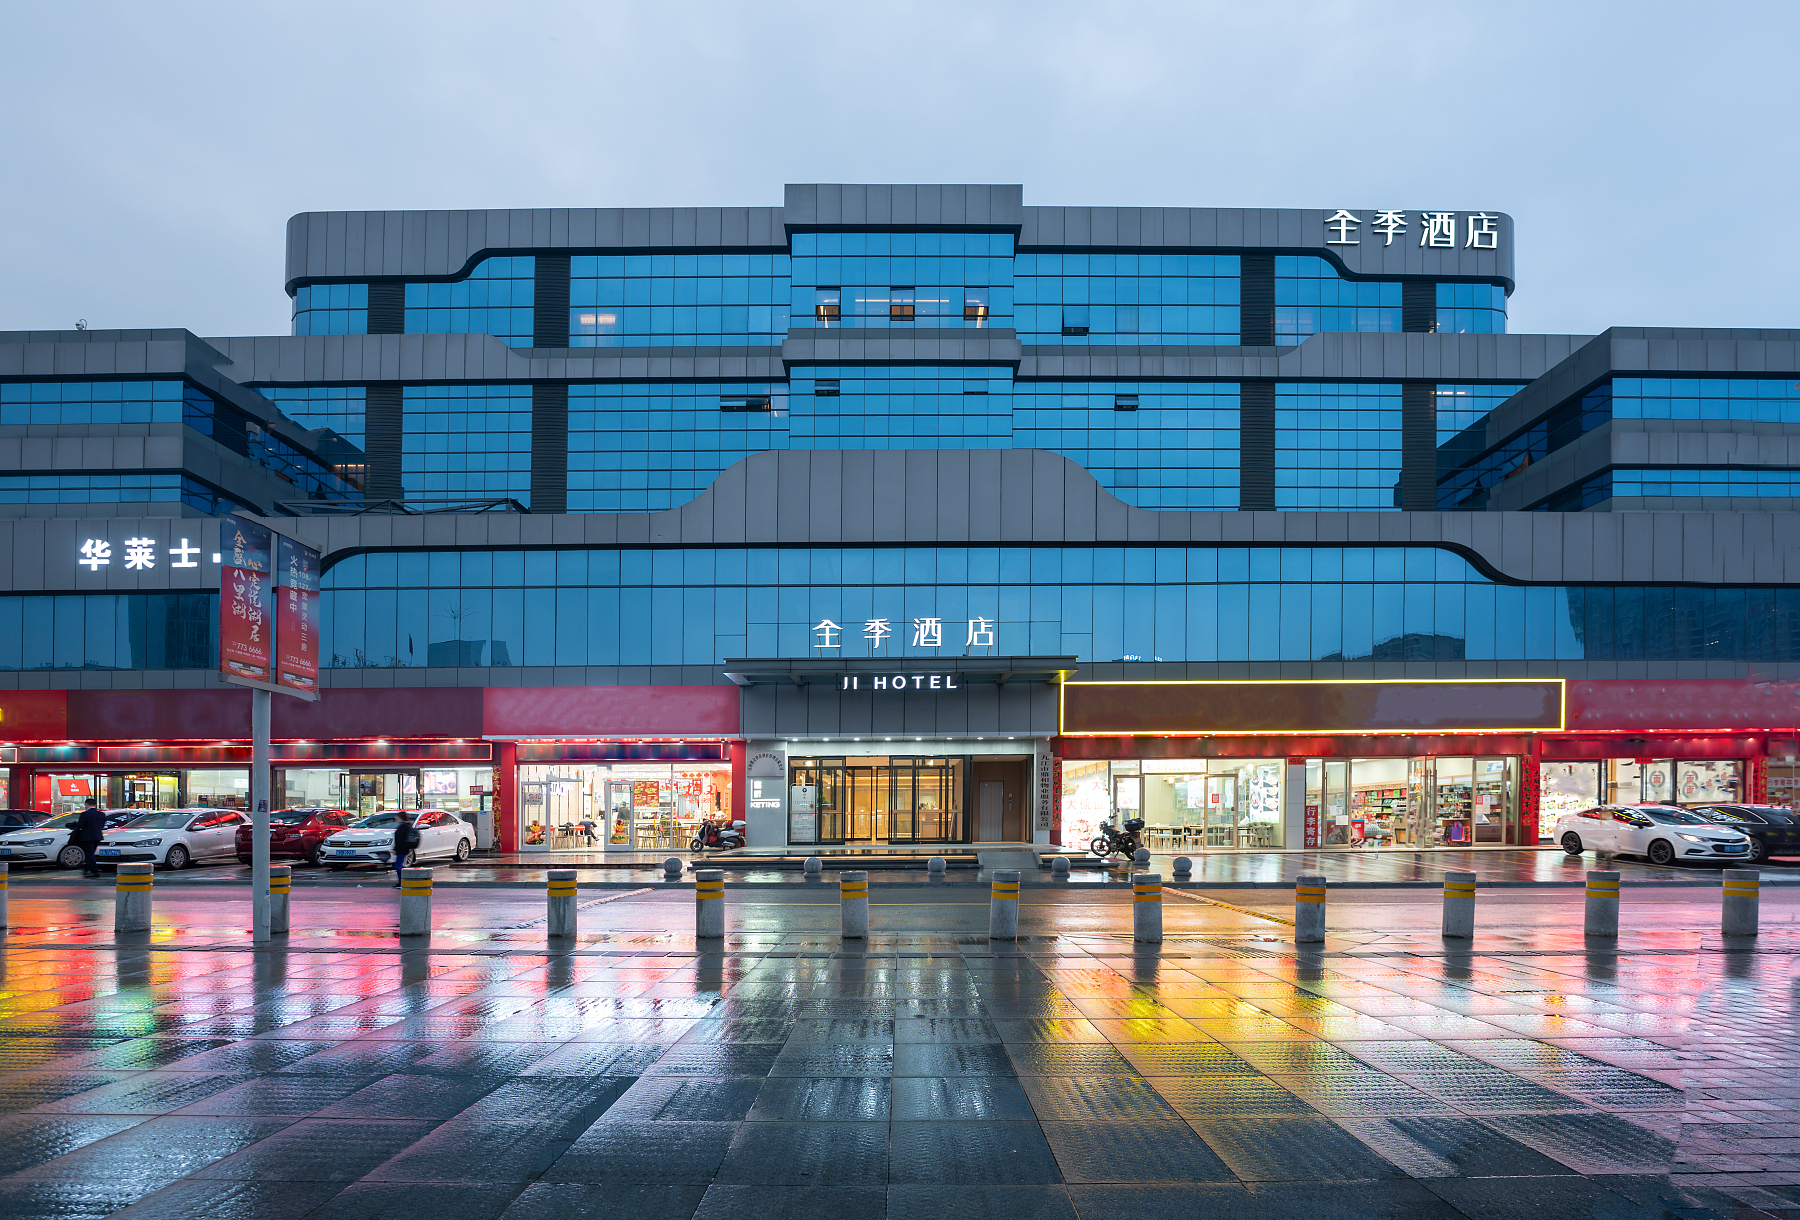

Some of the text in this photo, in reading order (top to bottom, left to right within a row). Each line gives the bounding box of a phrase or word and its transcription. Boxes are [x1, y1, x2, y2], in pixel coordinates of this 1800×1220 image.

[1324, 210, 1499, 249] 全季酒店
[79, 537, 201, 571] 华莱士
[812, 617, 996, 649] 全季酒店
[237, 642, 247, 652] 773
[248, 645, 263, 655] 6666
[289, 655, 299, 664] 773
[299, 658, 311, 667] 6666
[843, 676, 958, 690] JI HOTEL
[750, 801, 781, 809] KETING
[1306, 806, 1317, 846] 行李寄存
